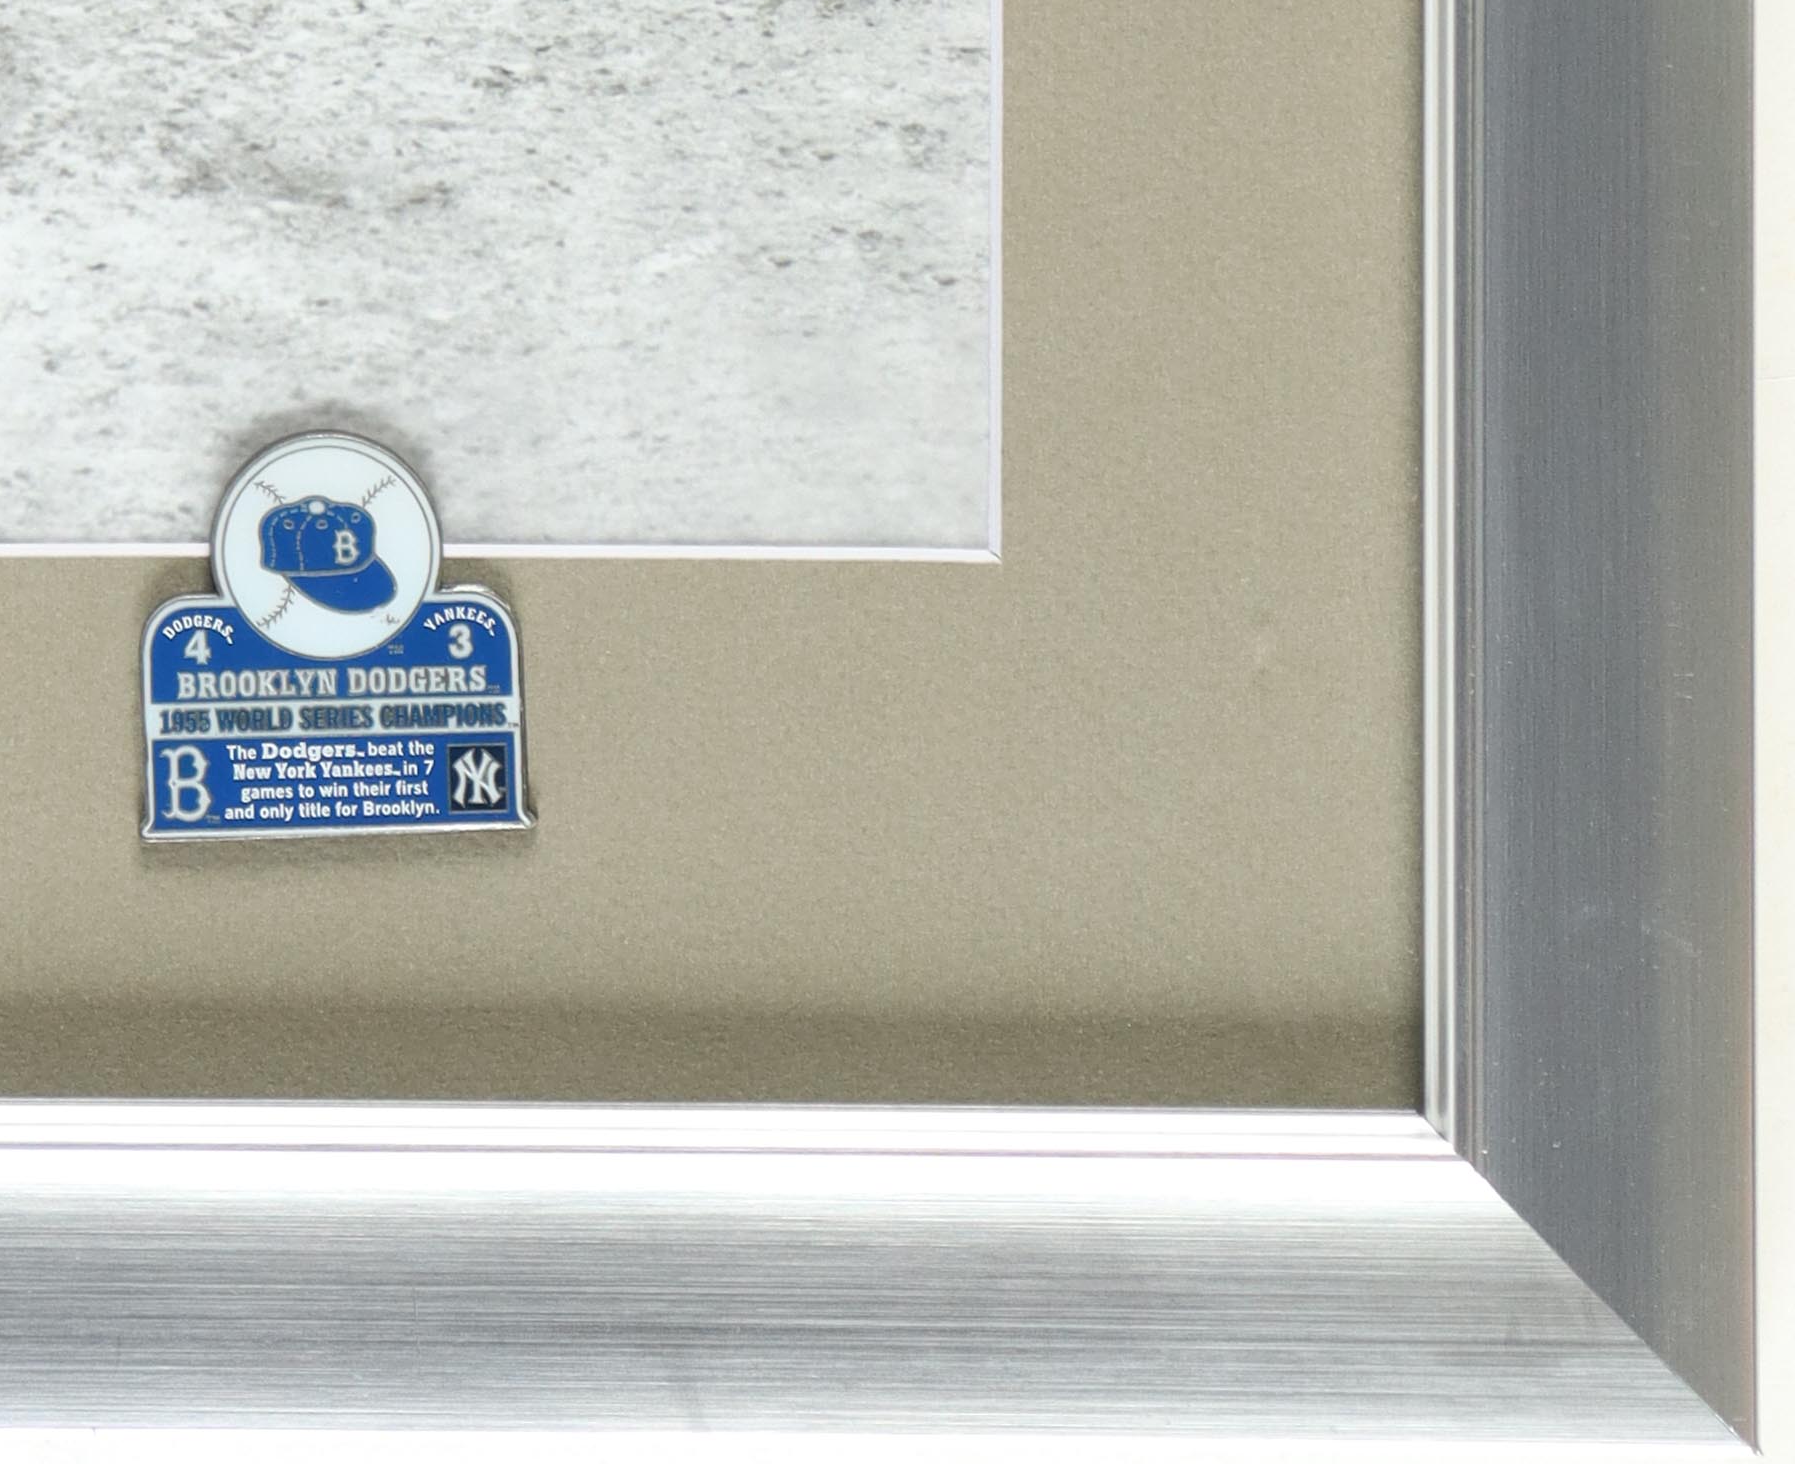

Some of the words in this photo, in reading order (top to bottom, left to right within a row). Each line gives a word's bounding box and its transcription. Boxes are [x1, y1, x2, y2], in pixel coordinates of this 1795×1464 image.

[333, 529, 360, 565] B
[162, 615, 234, 640] DODGERS
[423, 606, 496, 632] YANKEES
[183, 629, 211, 665] 4
[448, 623, 473, 659] 3
[177, 668, 338, 700] BROOKLYN
[347, 665, 487, 695] DODGERS
[160, 706, 211, 734] 1955
[215, 707, 294, 733] WORLD
[298, 704, 374, 730] SERIES
[379, 702, 507, 729] CHAMPIONS
[226, 745, 257, 761] The
[261, 742, 356, 762] Dodgers
[367, 741, 404, 757] beat
[408, 740, 435, 756] the
[160, 745, 211, 822] B
[233, 763, 272, 781] New
[275, 762, 317, 779] York
[320, 760, 394, 779] Yankees
[403, 760, 418, 776] in
[423, 760, 435, 775] 7
[241, 786, 294, 804] games
[298, 784, 315, 799] to
[319, 782, 349, 798] win
[353, 781, 392, 797] their
[395, 780, 429, 796] first
[224, 804, 255, 821] and
[259, 803, 294, 822] only
[298, 802, 331, 818] title
[335, 802, 359, 817] for
[363, 800, 441, 818] Brooklyn.
